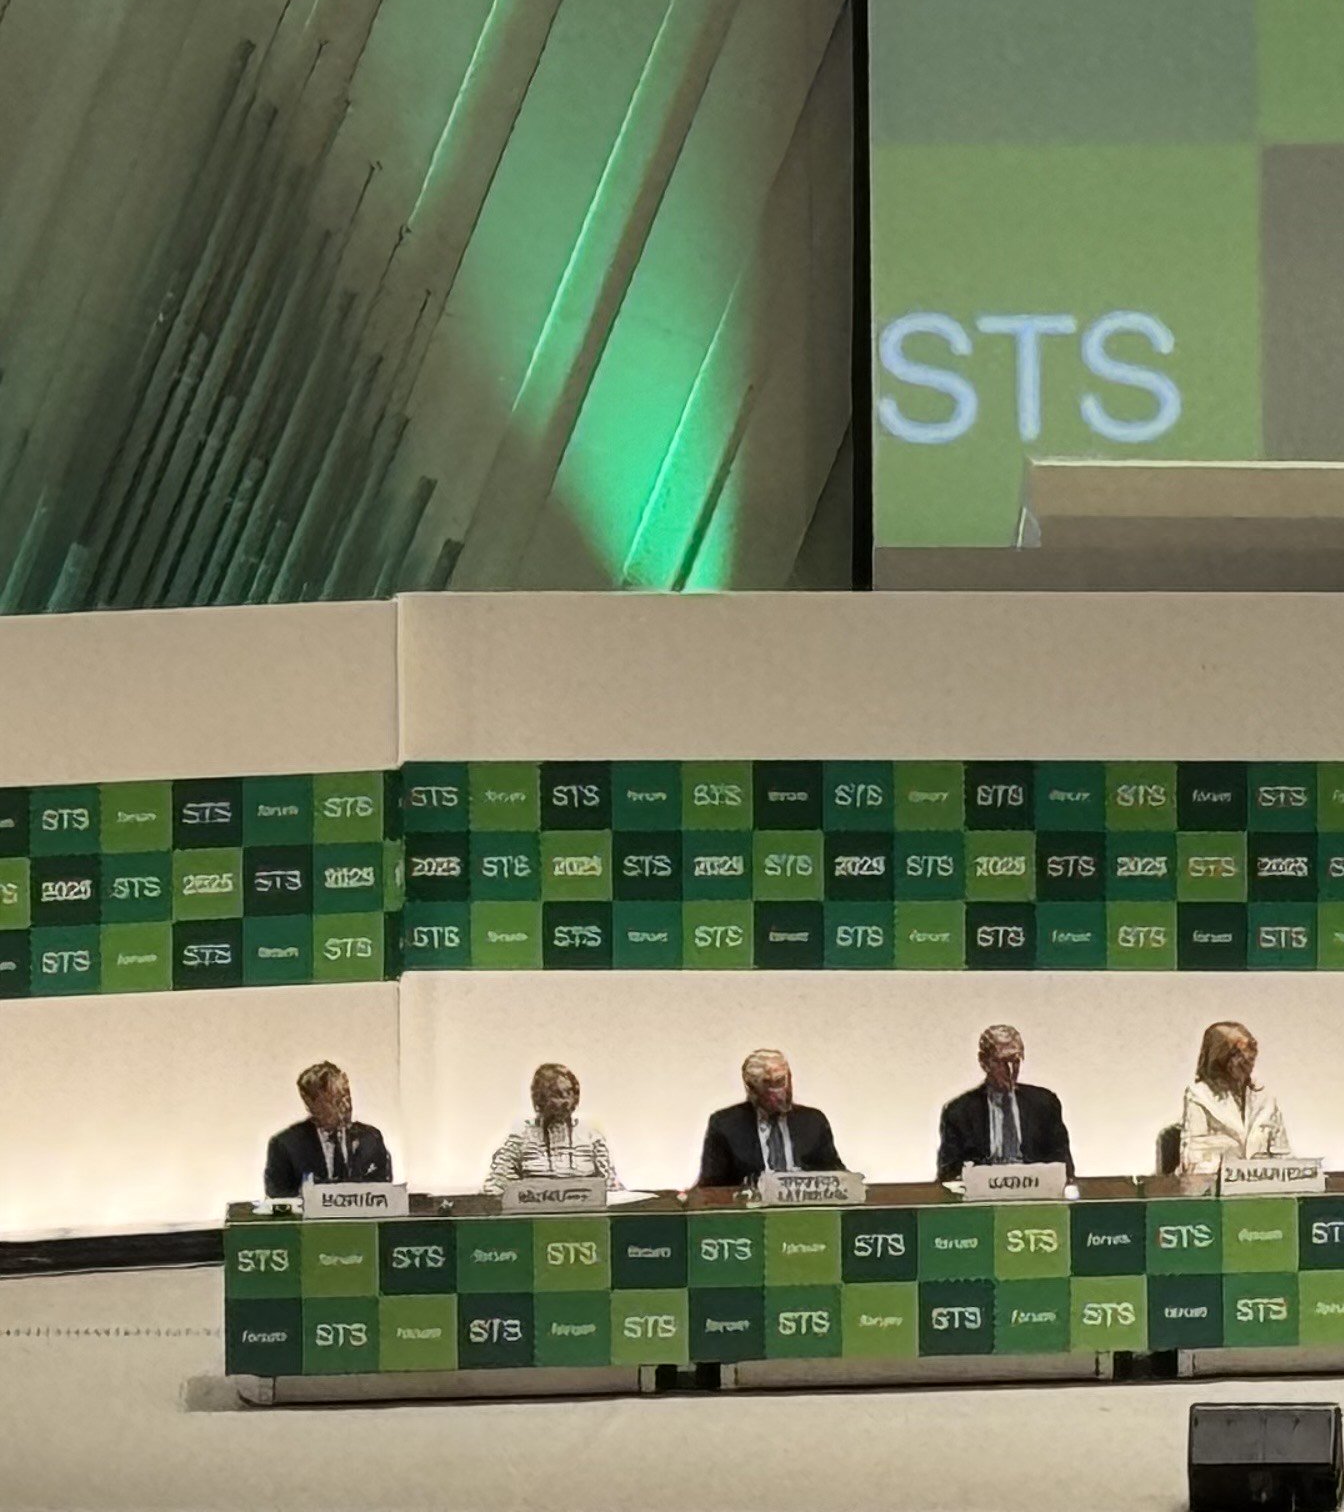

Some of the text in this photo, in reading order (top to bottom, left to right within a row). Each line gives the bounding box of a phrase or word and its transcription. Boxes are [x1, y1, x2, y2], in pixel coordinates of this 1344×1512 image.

[876, 311, 1182, 443] STS
[238, 1249, 289, 1272] STS
[393, 1246, 445, 1268] STS
[547, 1242, 600, 1265] STS
[701, 1238, 751, 1261] STS
[854, 1234, 905, 1257] STS
[1007, 1229, 1058, 1252] STS
[1160, 1225, 1212, 1248] STS
[316, 1323, 367, 1346] STS
[470, 1318, 522, 1342] STS
[624, 1315, 677, 1338] STS
[779, 1311, 830, 1334] STS
[932, 1307, 981, 1329] STS
[1083, 1302, 1135, 1327] STS
[1237, 1298, 1287, 1322] STS
